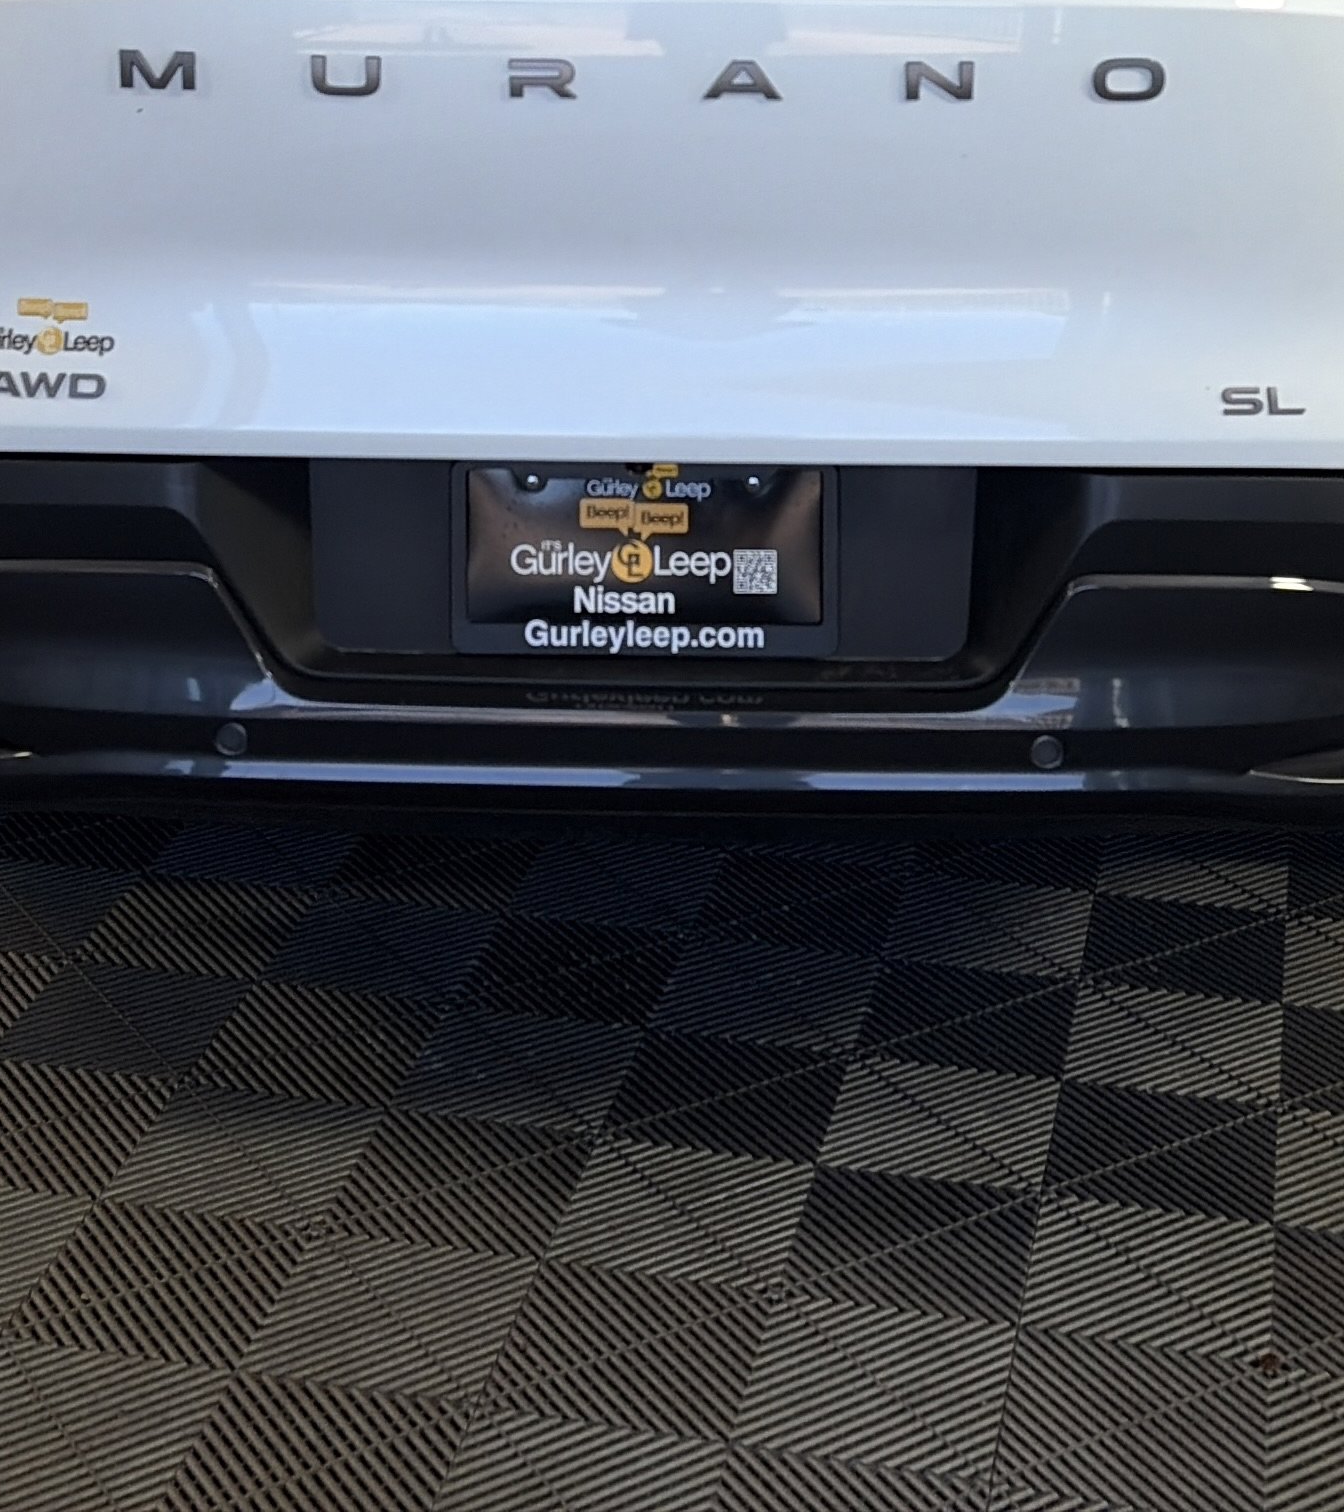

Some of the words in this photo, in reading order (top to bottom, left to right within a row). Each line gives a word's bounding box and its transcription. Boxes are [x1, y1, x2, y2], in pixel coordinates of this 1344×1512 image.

[117, 49, 1168, 102] MURANO
[63, 331, 115, 356] Leep
[1221, 386, 1306, 416] SL
[665, 479, 712, 502] Leep
[586, 505, 630, 521] Beep!
[640, 512, 685, 526] Beep!
[510, 541, 612, 584] Gurley
[653, 544, 732, 584] Leep
[573, 585, 675, 615] Nissan
[524, 619, 765, 655] Gurleyleep.com
